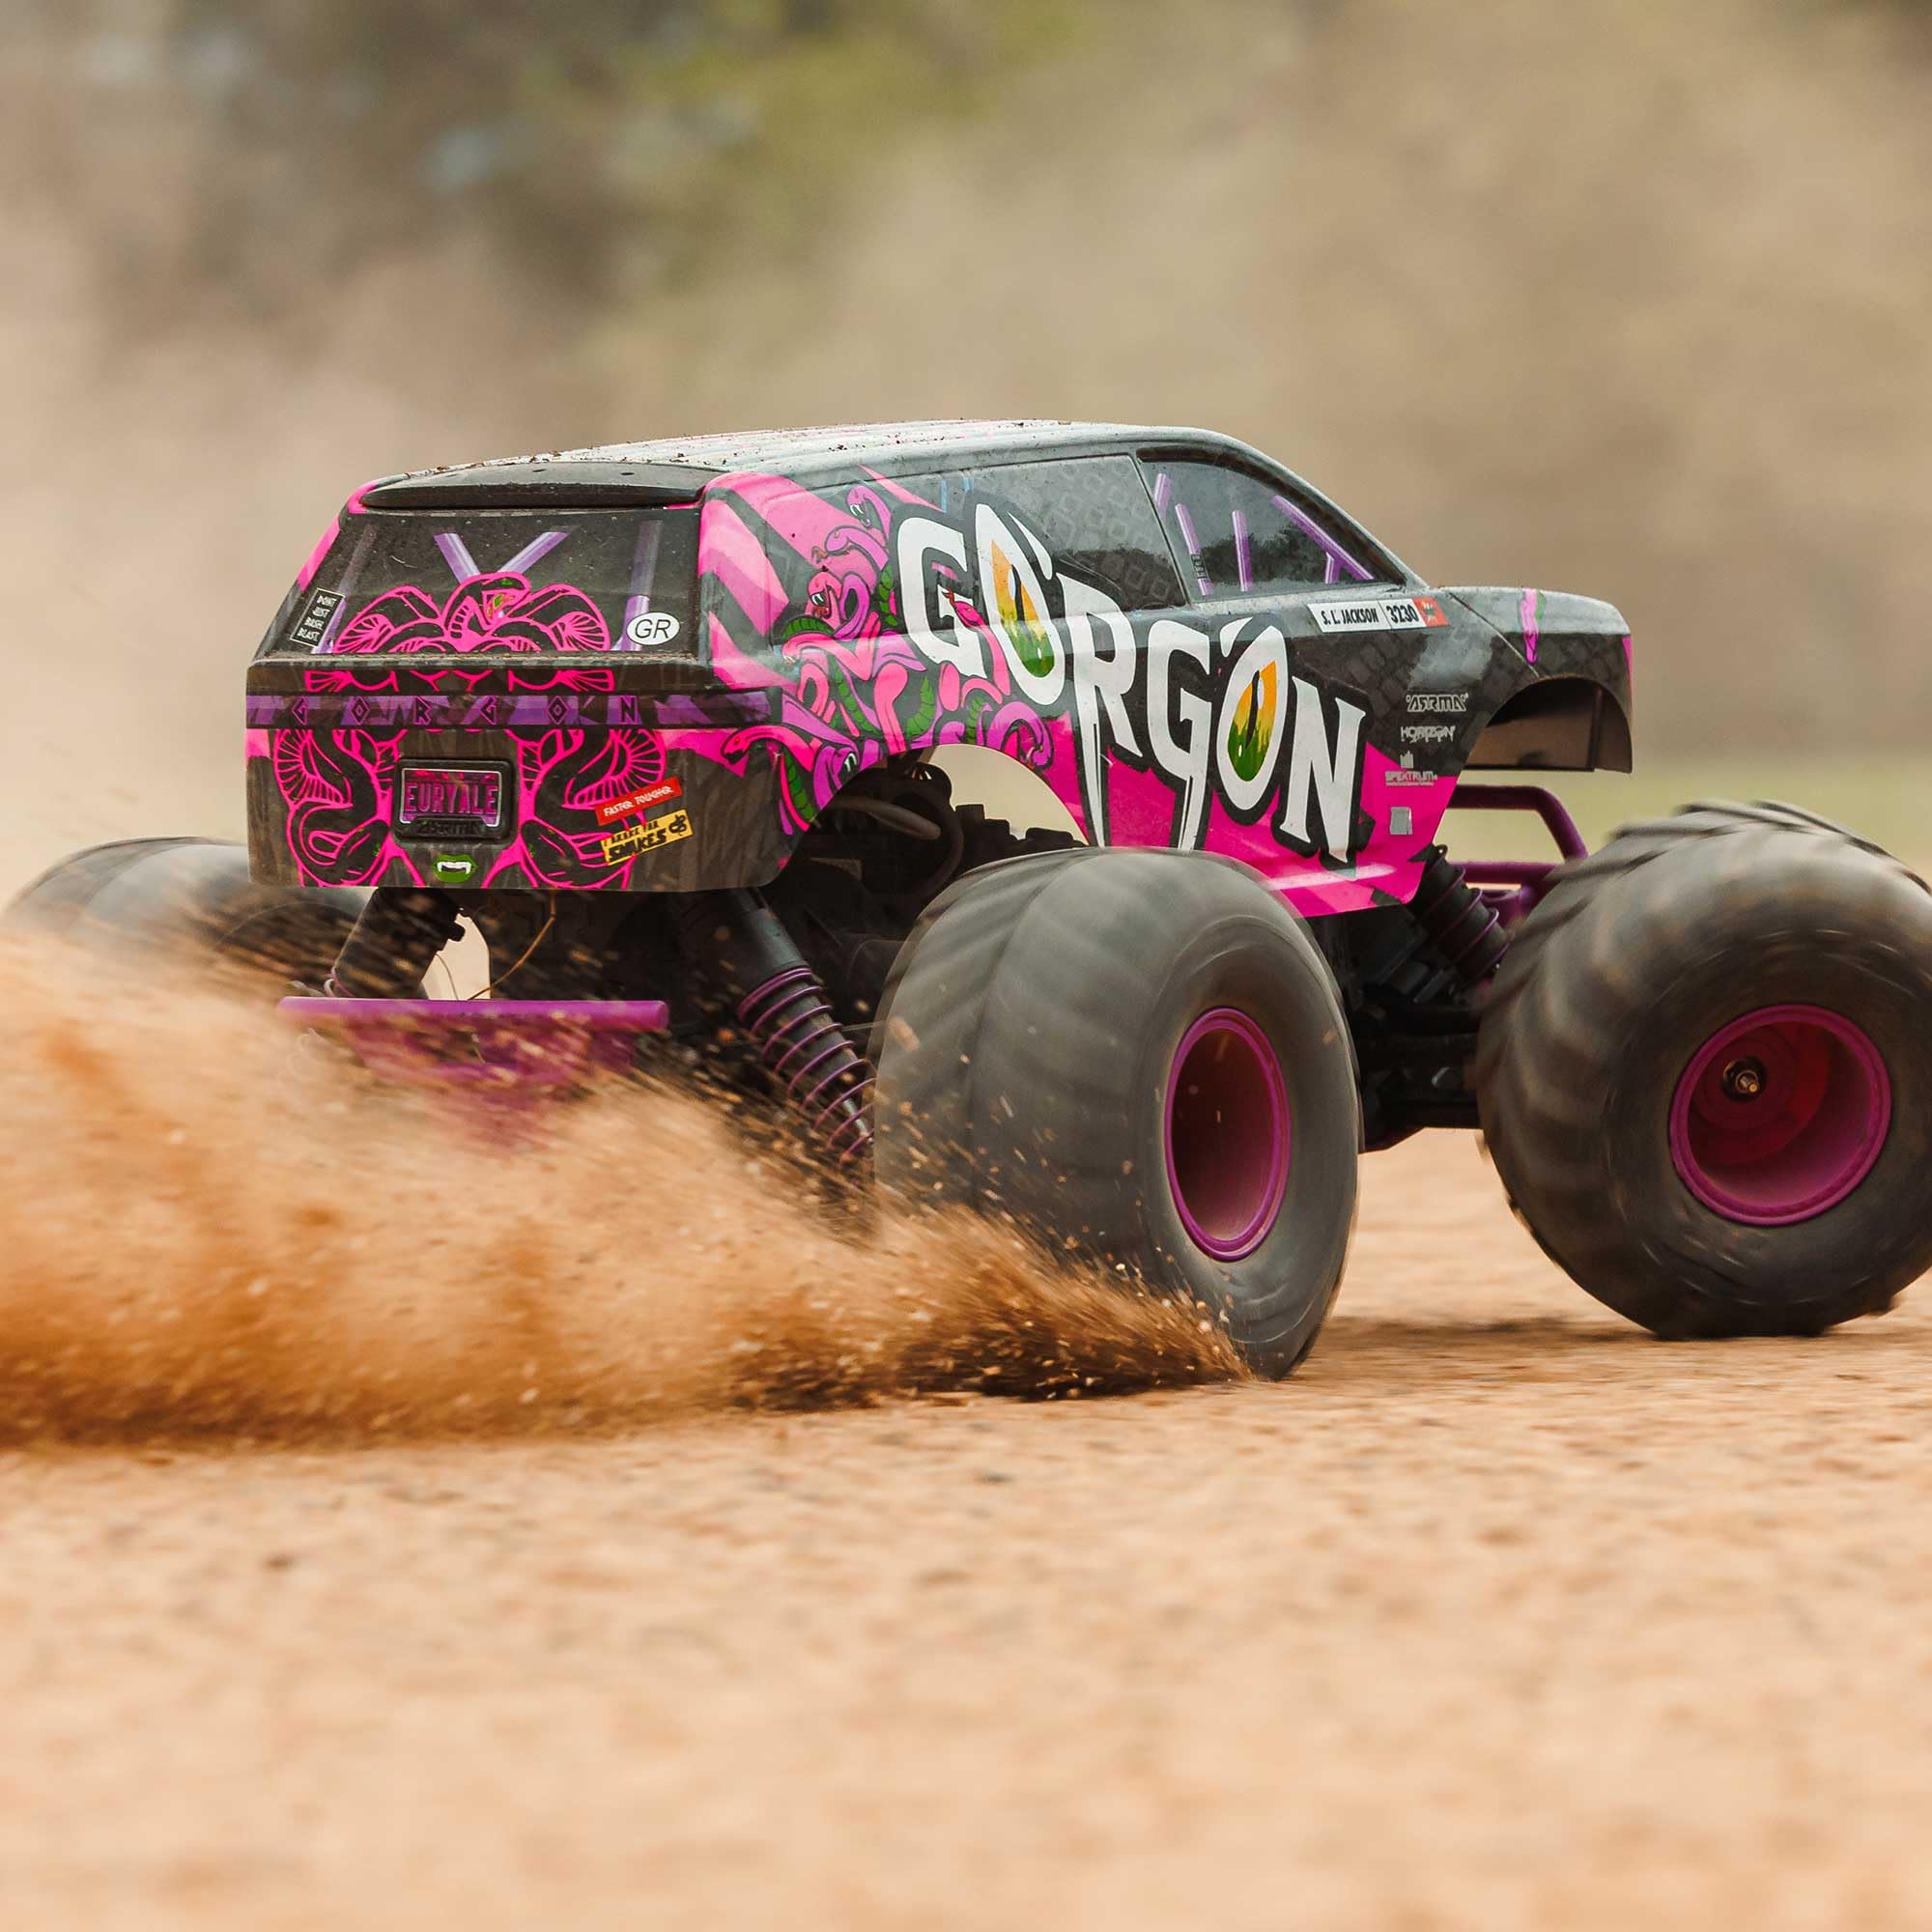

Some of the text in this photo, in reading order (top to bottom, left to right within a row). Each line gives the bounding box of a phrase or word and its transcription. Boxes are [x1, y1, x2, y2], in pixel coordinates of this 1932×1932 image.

[635, 618, 669, 639] GR
[1321, 611, 1331, 625] S.
[1341, 608, 1379, 624] JACKSON
[1386, 604, 1419, 623] 3230
[897, 502, 1366, 864] GORGON
[292, 696, 639, 725] GORGON
[404, 782, 498, 814] EURYALE
